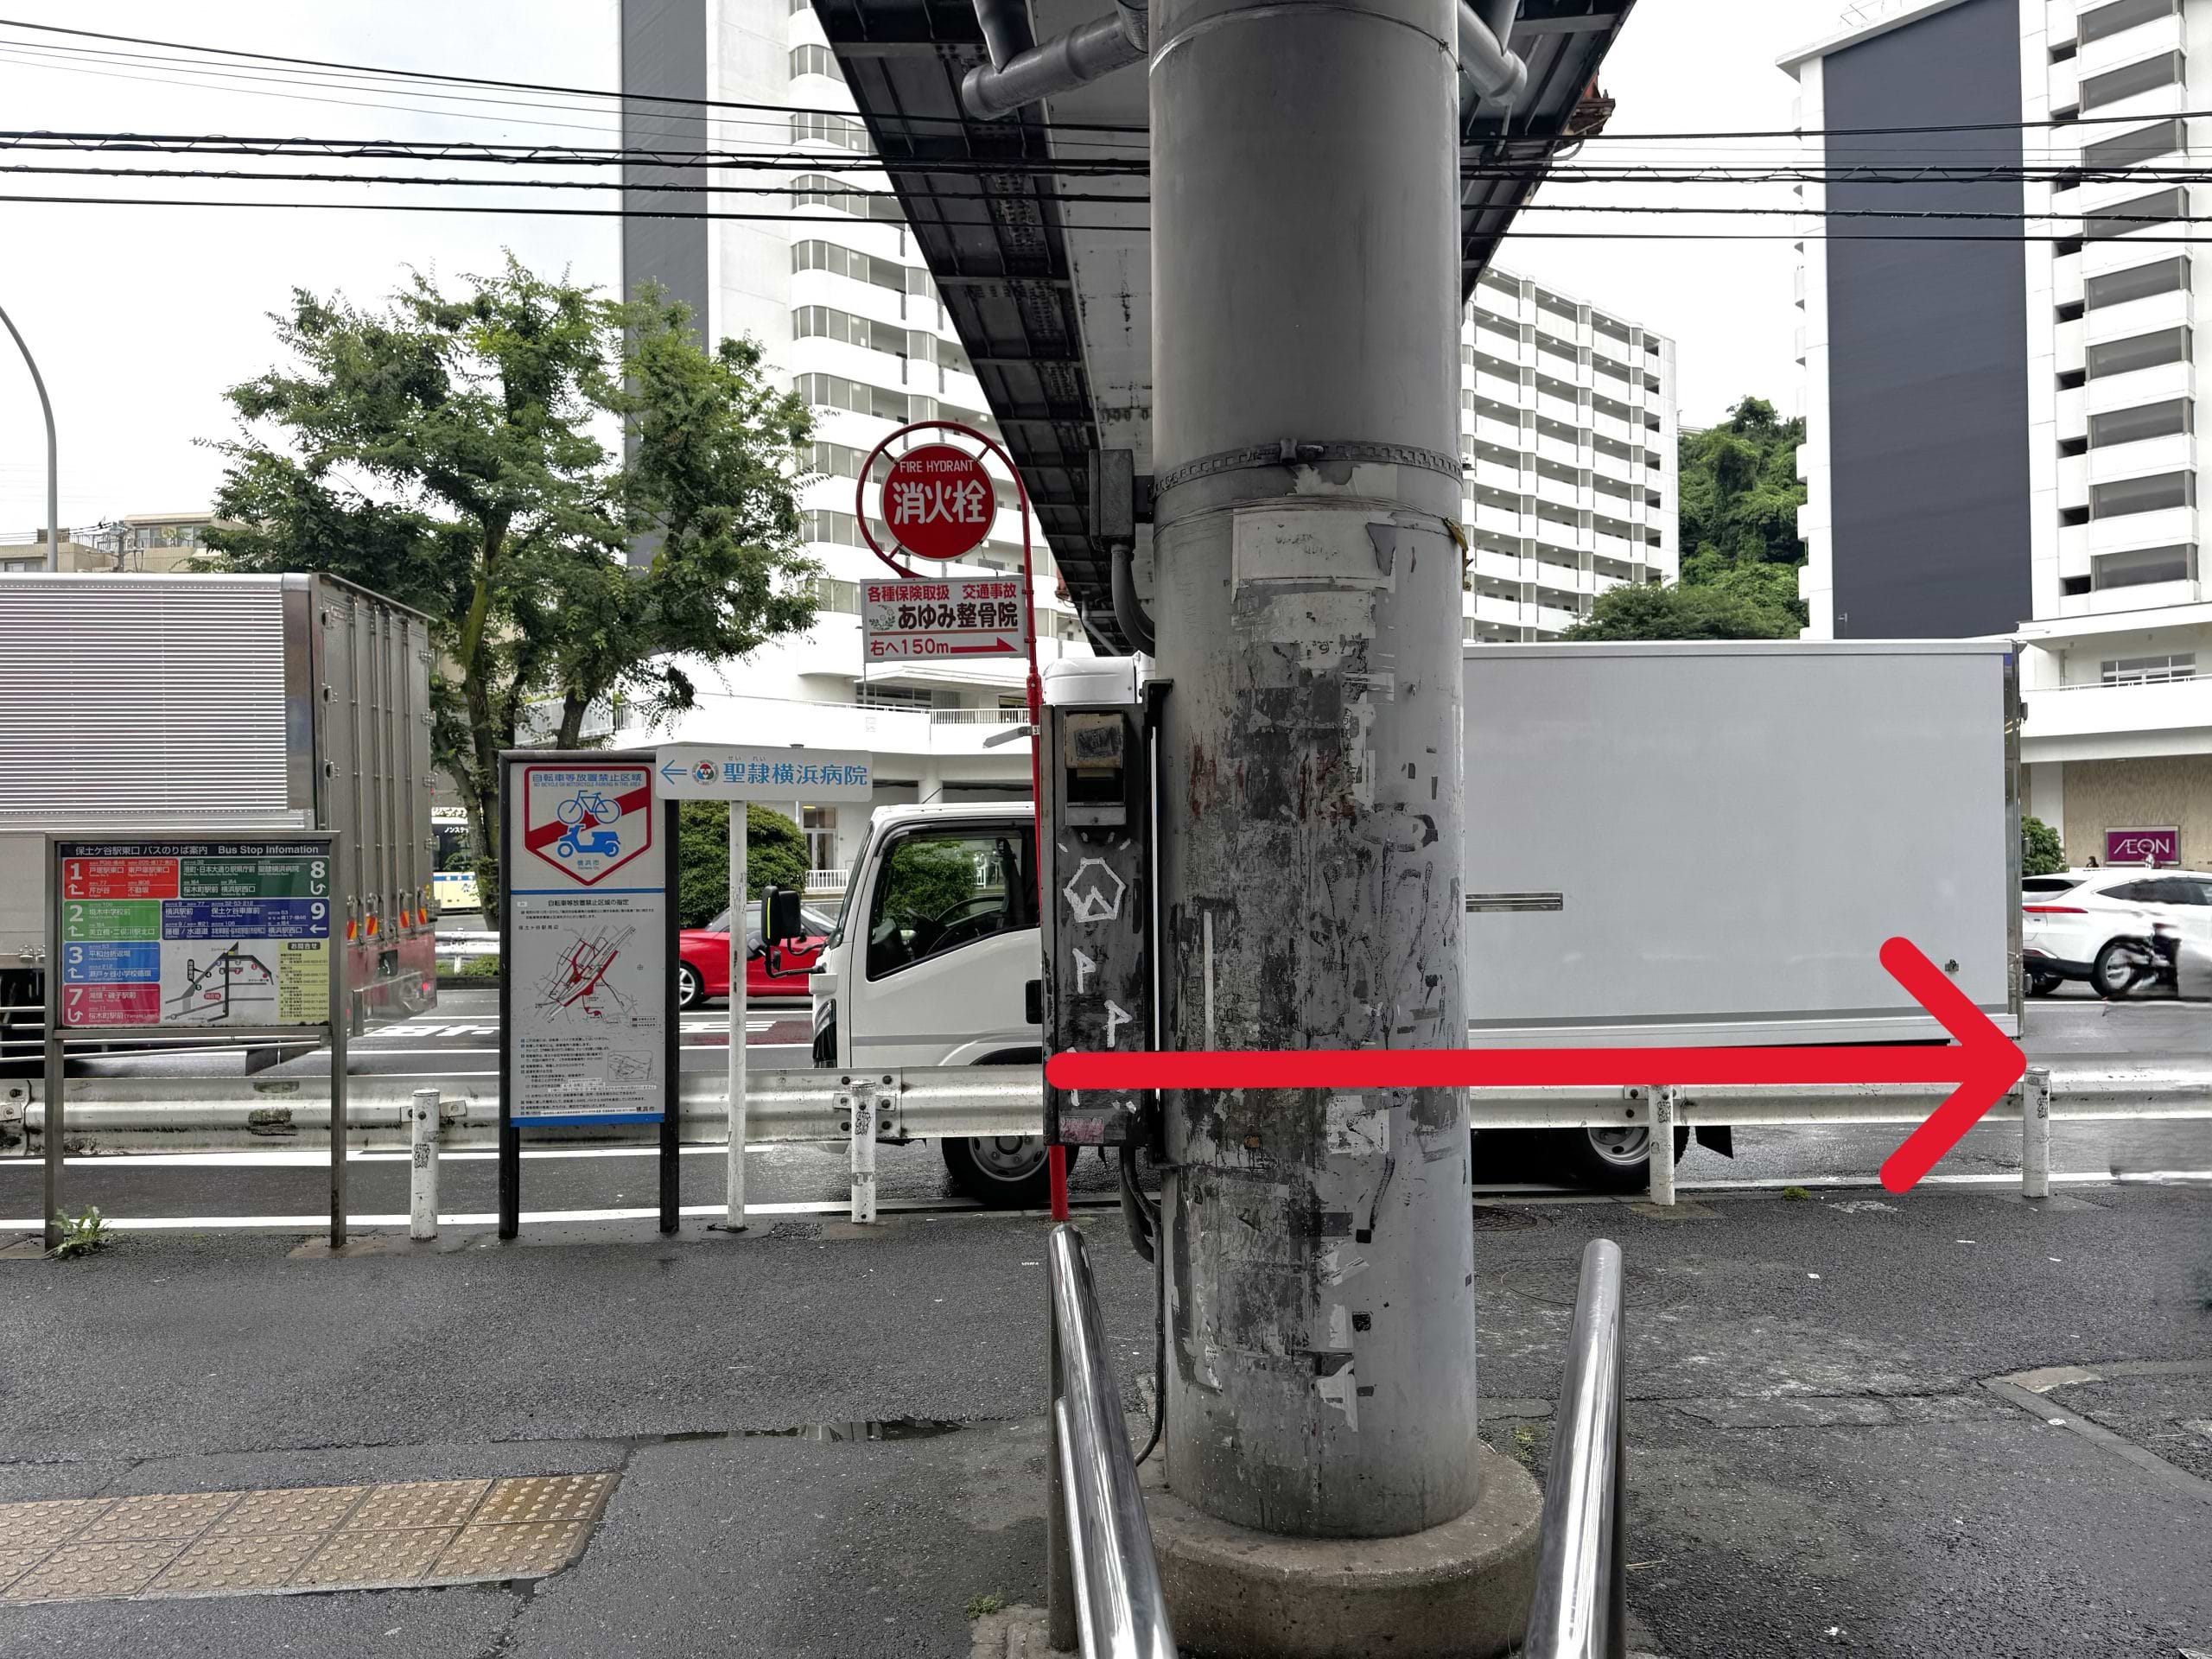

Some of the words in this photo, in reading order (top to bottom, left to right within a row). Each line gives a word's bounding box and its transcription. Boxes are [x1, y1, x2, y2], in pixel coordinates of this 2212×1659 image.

[899, 461, 923, 474] FIRE
[926, 460, 975, 473] HYDRANT
[893, 479, 986, 524] 消火栓
[868, 584, 950, 603] 各種保険取扱
[963, 582, 1017, 600] 交通事故
[898, 601, 1018, 630] あゆみ整骨院
[870, 639, 950, 657] 右へ150m
[532, 773, 642, 782] 自転車等放置禁止区域
[723, 762, 868, 785] 聖隷横浜病院
[143, 846, 208, 855] バスのりば案内
[240, 846, 264, 855] Stop
[266, 845, 319, 854] Infomation
[71, 862, 83, 880] 1
[310, 861, 326, 879] 8
[69, 905, 84, 922] 2
[310, 902, 326, 920] 9
[69, 946, 83, 964] 3
[69, 988, 83, 1006] 7
